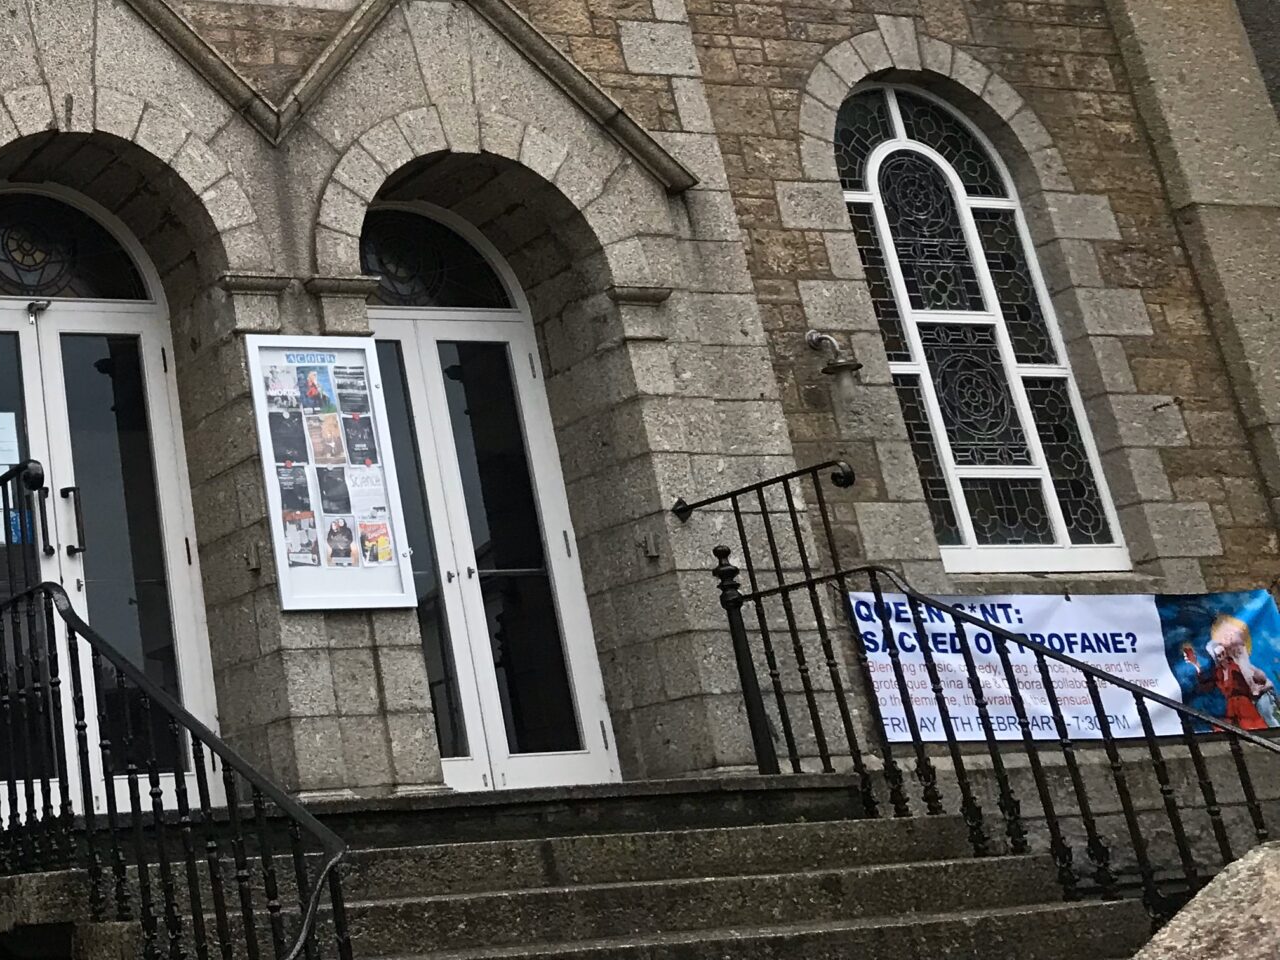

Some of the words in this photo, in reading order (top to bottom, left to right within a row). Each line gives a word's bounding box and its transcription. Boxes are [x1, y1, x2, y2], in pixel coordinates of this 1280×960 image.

[974, 632, 1011, 654] O
[868, 660, 917, 675] Blenng
[918, 661, 957, 673] msic,
[960, 661, 1001, 676] cedy,
[1006, 661, 1031, 676] rag,
[1033, 661, 1069, 675] nce,
[1104, 661, 1123, 673] and
[1123, 660, 1140, 673] the
[872, 678, 928, 693] groteque
[1052, 677, 1108, 690] collabote
[890, 694, 906, 706] th
[910, 694, 961, 707] femine,
[963, 694, 980, 706] th
[1053, 694, 1093, 706] ensual
[881, 716, 937, 732] FRIAY
[942, 716, 973, 732] TH
[977, 715, 1062, 732] FEBRAR
[1106, 714, 1131, 730] PM
